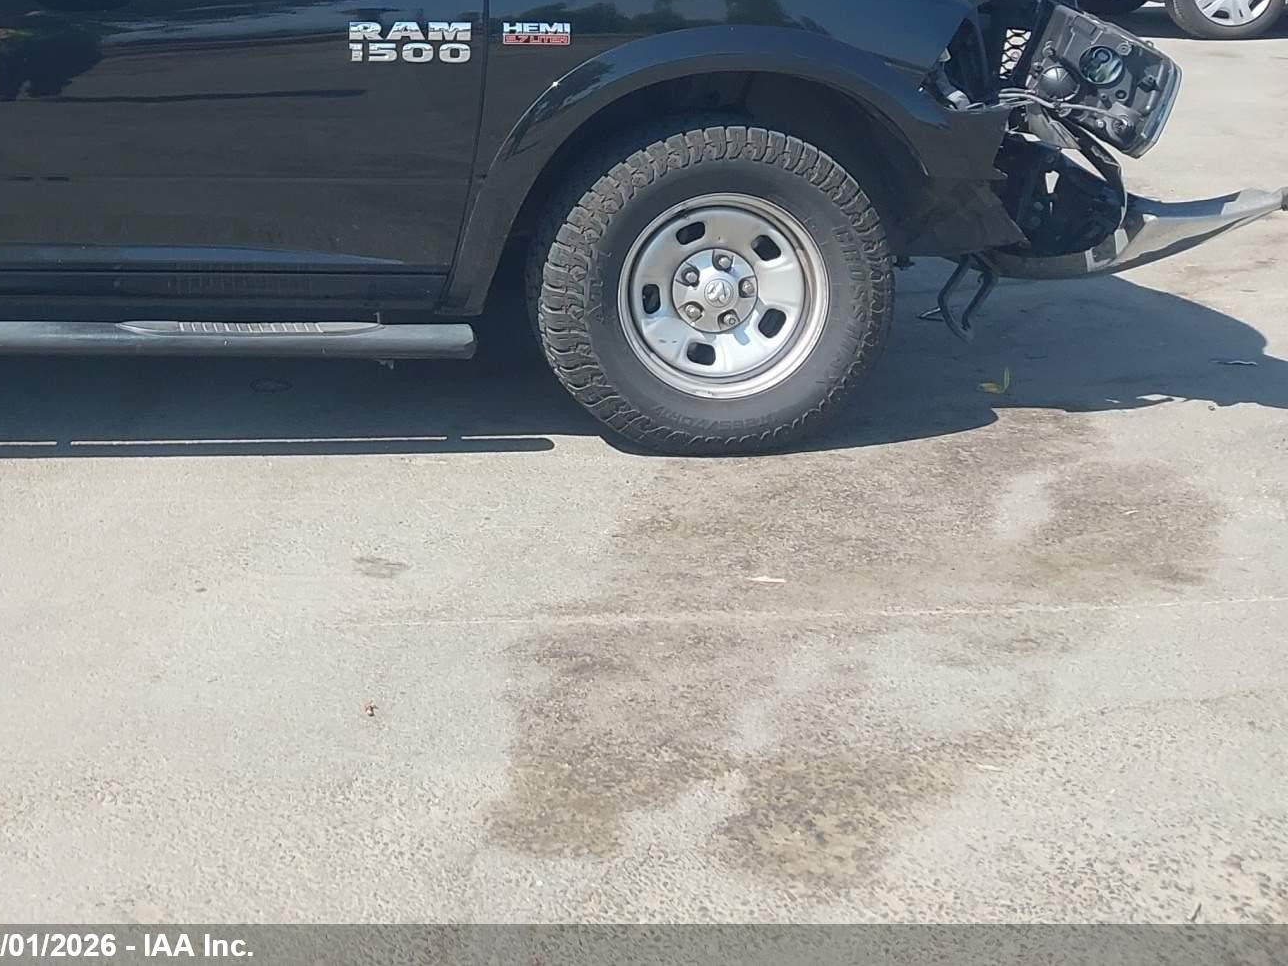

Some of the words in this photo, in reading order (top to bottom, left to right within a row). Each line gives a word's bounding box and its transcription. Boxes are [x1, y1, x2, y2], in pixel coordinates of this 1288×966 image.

[348, 21, 472, 41] RAM
[503, 22, 571, 34] HEMI
[530, 35, 568, 43] LITER
[349, 43, 472, 63] 1500
